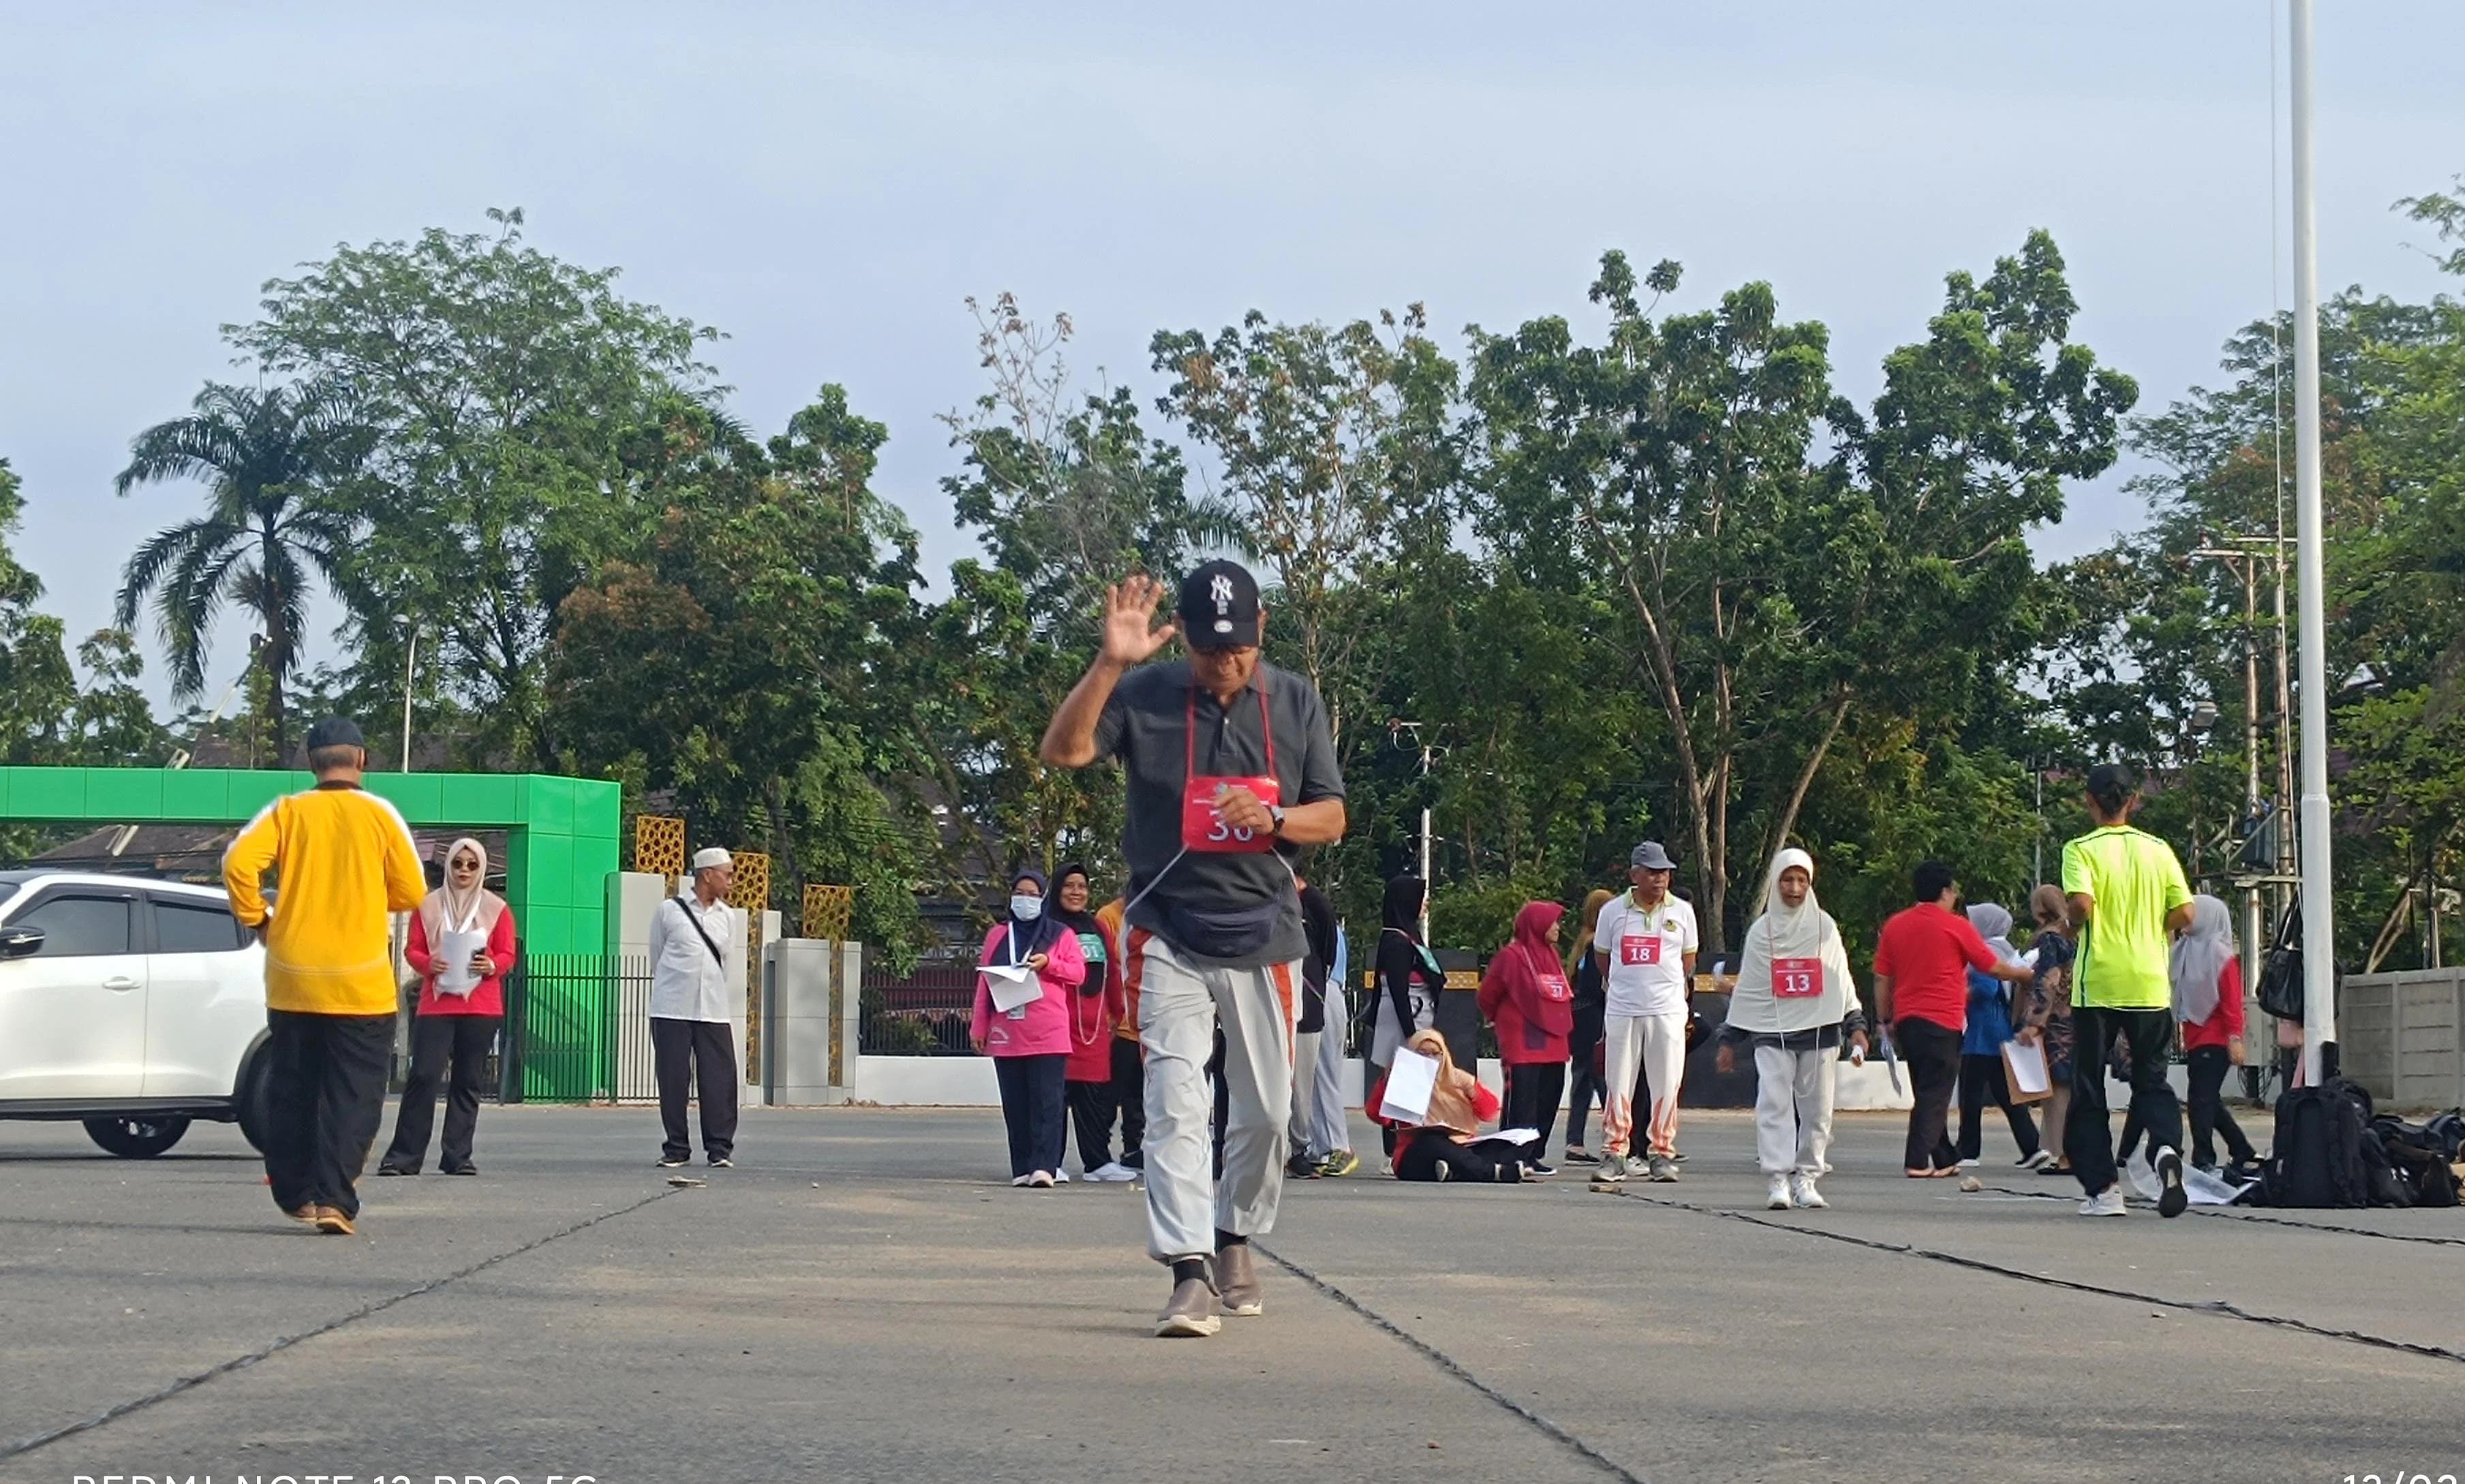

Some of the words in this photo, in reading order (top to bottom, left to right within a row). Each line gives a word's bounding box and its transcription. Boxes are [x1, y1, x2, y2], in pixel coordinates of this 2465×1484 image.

[1210, 574, 1233, 601] NY
[1630, 948, 1651, 961] 18
[1786, 974, 1810, 992] 13
